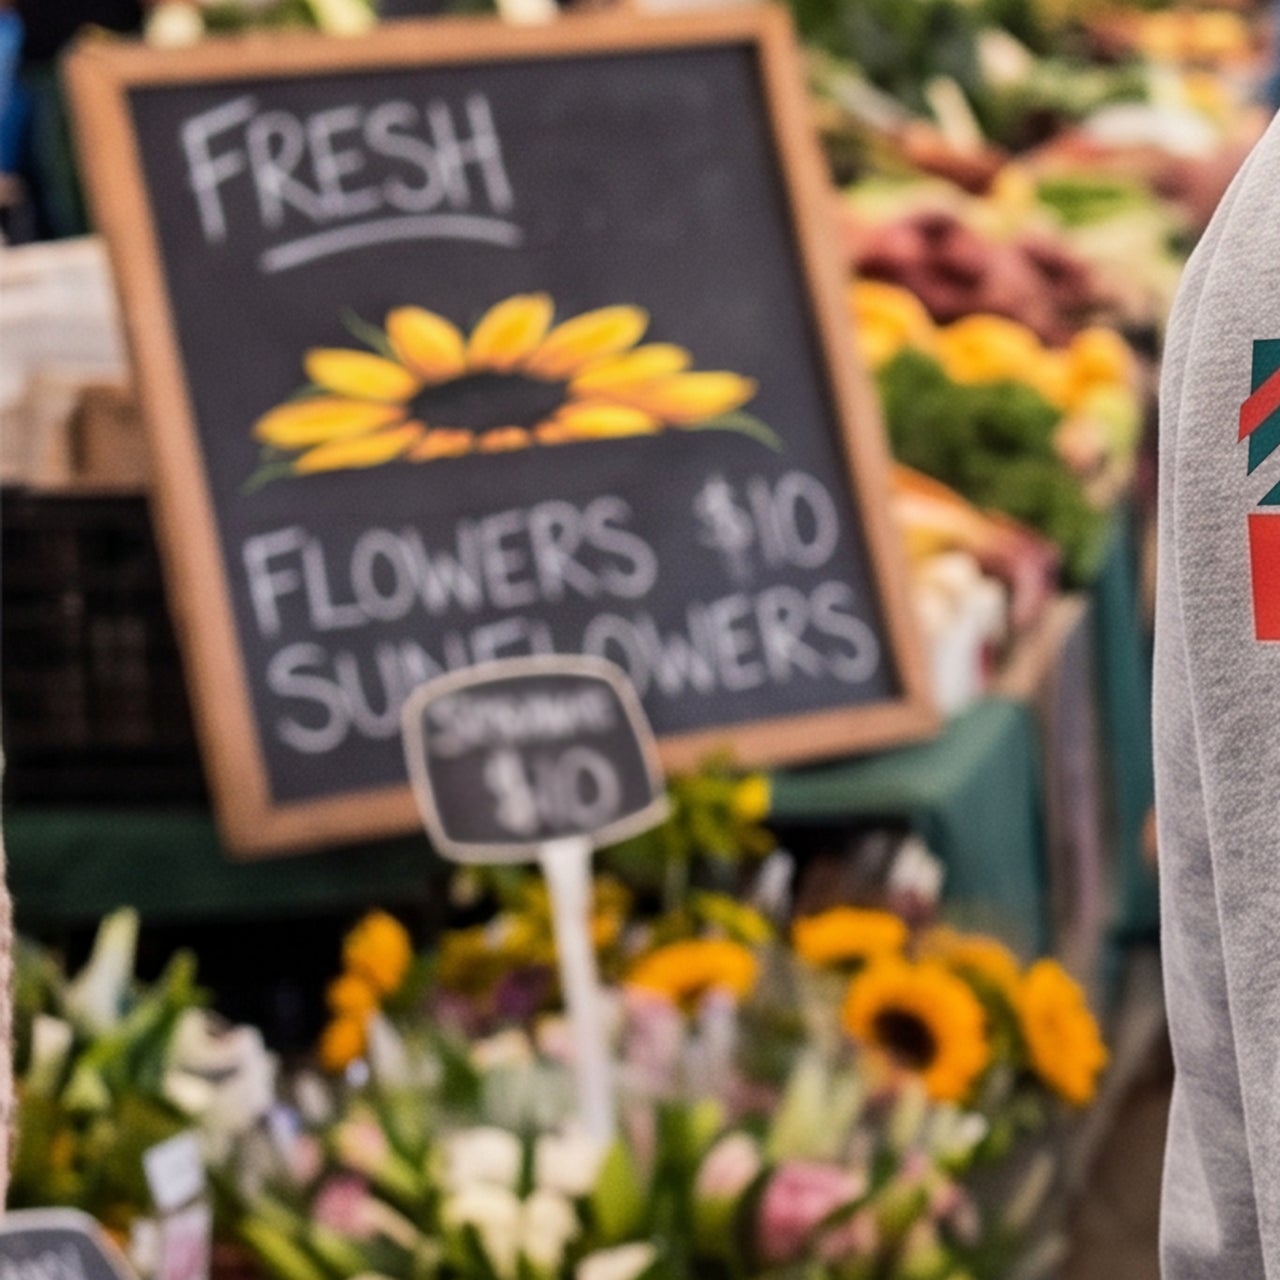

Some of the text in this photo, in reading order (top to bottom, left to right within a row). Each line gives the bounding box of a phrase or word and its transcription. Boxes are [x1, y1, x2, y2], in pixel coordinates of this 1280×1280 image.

[180, 93, 515, 242] FRESH
[242, 470, 840, 636] FLOWERS $10
